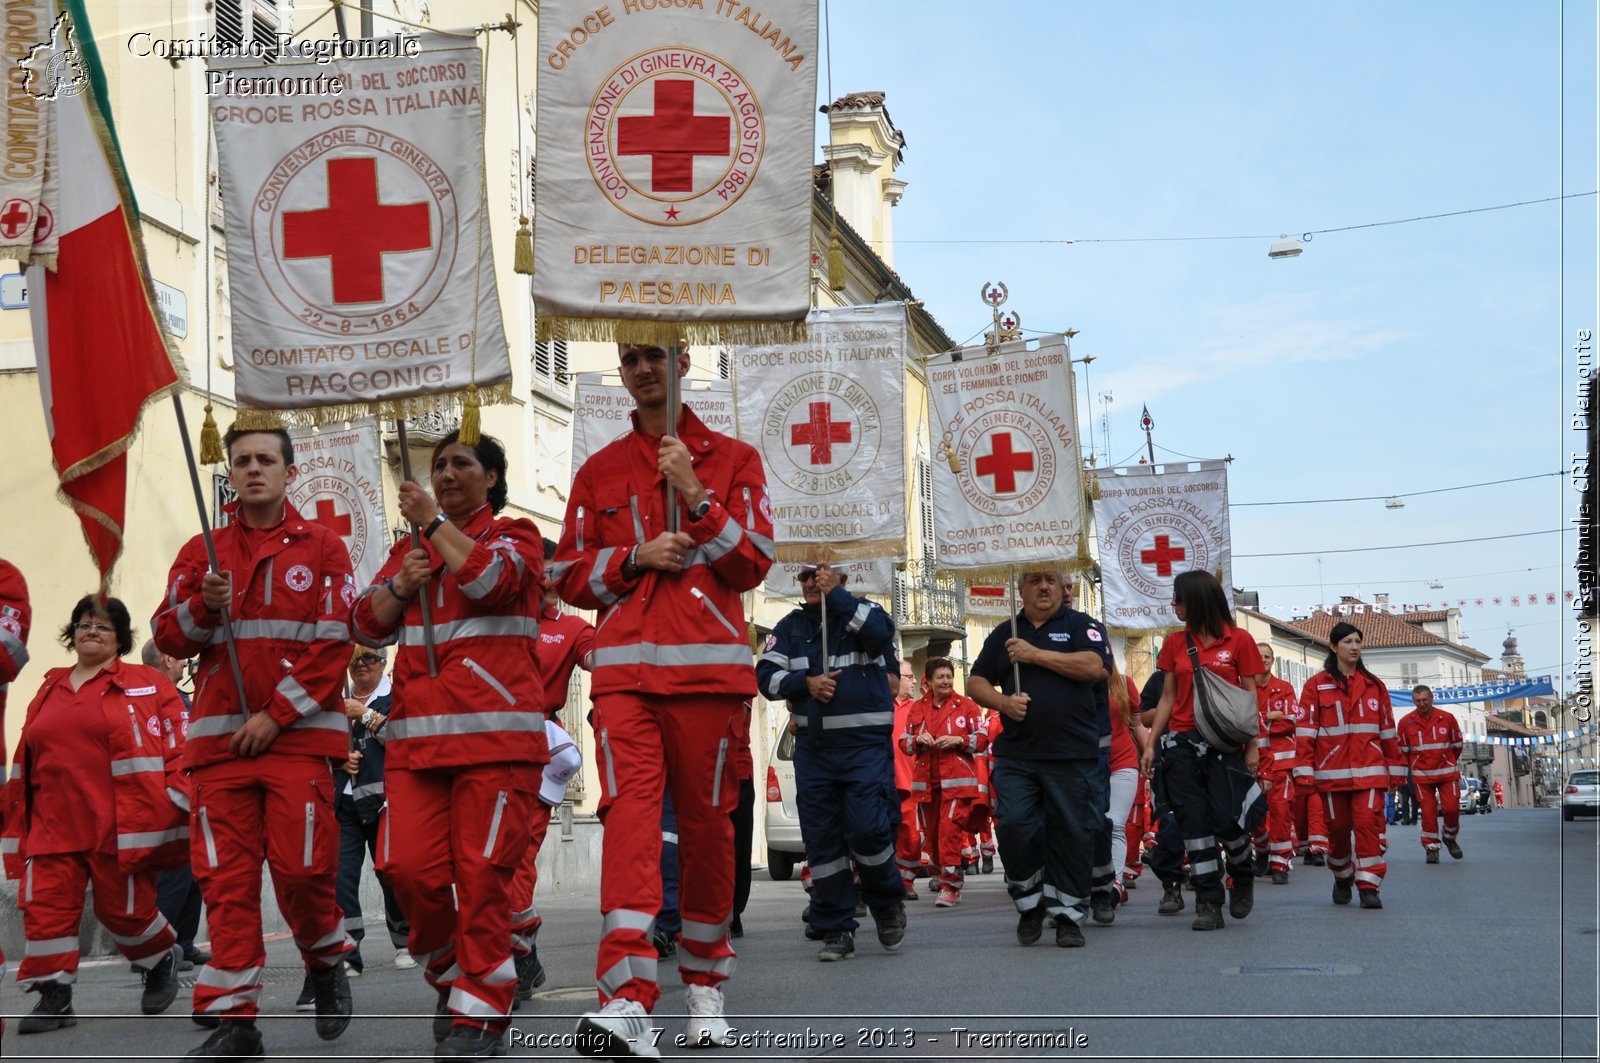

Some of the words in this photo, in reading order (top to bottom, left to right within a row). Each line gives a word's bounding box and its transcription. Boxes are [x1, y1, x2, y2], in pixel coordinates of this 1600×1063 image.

[549, 5, 615, 70] CROCE
[716, 0, 804, 71] ITALIANA
[361, 73, 391, 91] DEL
[397, 62, 466, 89] SOCCORSO
[620, 66, 639, 85] DI
[640, 53, 716, 79] GINEVRA
[717, 71, 740, 93] 22
[214, 104, 294, 125] CROCE
[302, 98, 379, 121] ROSSA
[386, 86, 480, 116] ITALIANA
[4, 66, 41, 180] COMITATO
[733, 92, 760, 165] AGOSTO
[590, 80, 628, 201] CONVENZIONE
[258, 129, 357, 213] CONVENZIONE
[366, 132, 385, 148] DI
[390, 140, 451, 201] GINEVRA
[717, 168, 748, 201] 1864
[574, 245, 735, 266] DELEGAZIONE
[747, 247, 770, 266] DI
[600, 281, 736, 305] PAESANA
[301, 302, 420, 333] 22-8-1864
[251, 345, 355, 366] COMITATO
[364, 337, 449, 361] LOCALE
[742, 352, 785, 367] CROCE
[790, 348, 833, 364] ROSSA
[838, 346, 895, 361] ITALIANA
[960, 362, 1000, 378] VOLONTARI
[1005, 360, 1020, 371] DEL
[1024, 354, 1063, 367] SOCCORSO
[286, 363, 450, 397] RACCONIGI
[961, 375, 1005, 391] FEMMINILE
[1007, 375, 1012, 384] E
[1015, 370, 1048, 384] PIONIERI
[585, 394, 612, 406] CORPO
[765, 375, 825, 437] CONVENZIONE
[829, 377, 843, 391] DI
[577, 407, 622, 420] CROCE
[982, 412, 1032, 431] GINEVRA
[936, 412, 965, 463] CROCE
[964, 390, 1016, 415] ROSSA
[1020, 392, 1072, 449] ITALIANA
[968, 426, 980, 440] DI
[1032, 429, 1046, 443] 22
[313, 439, 326, 450] DEL
[959, 442, 996, 512] CONVENZIONE
[1039, 446, 1053, 489] AGOSTO
[1018, 487, 1043, 510] 1864
[1100, 487, 1122, 498] CORPO
[1125, 486, 1164, 497] VOLONTARI
[1168, 485, 1181, 494] DEL
[1184, 482, 1219, 493] SOCCORSO
[295, 491, 306, 504] DI
[308, 479, 350, 496] GINEVRA
[355, 511, 365, 552] AGOSTO
[825, 503, 874, 517] LOCALE
[879, 501, 890, 514] DI
[789, 523, 863, 538] MONESIGLIO
[946, 524, 1005, 540] COMITATO
[1009, 521, 1057, 533] LOCALE
[1061, 520, 1073, 530] DI
[1104, 511, 1130, 551] CROCE
[1129, 497, 1175, 516] ROSSA
[1178, 500, 1222, 545] ITALIANA
[1131, 524, 1143, 535] DI
[940, 541, 986, 555] BORGO
[991, 540, 1003, 550] S.
[1008, 534, 1081, 549] DALMAZZO
[1189, 530, 1201, 542] 22
[1120, 537, 1157, 595] CONVENZIONE
[1115, 606, 1151, 617] GRUPPO
[1157, 605, 1166, 615] di
[1432, 687, 1511, 701] RIVEDERCI
